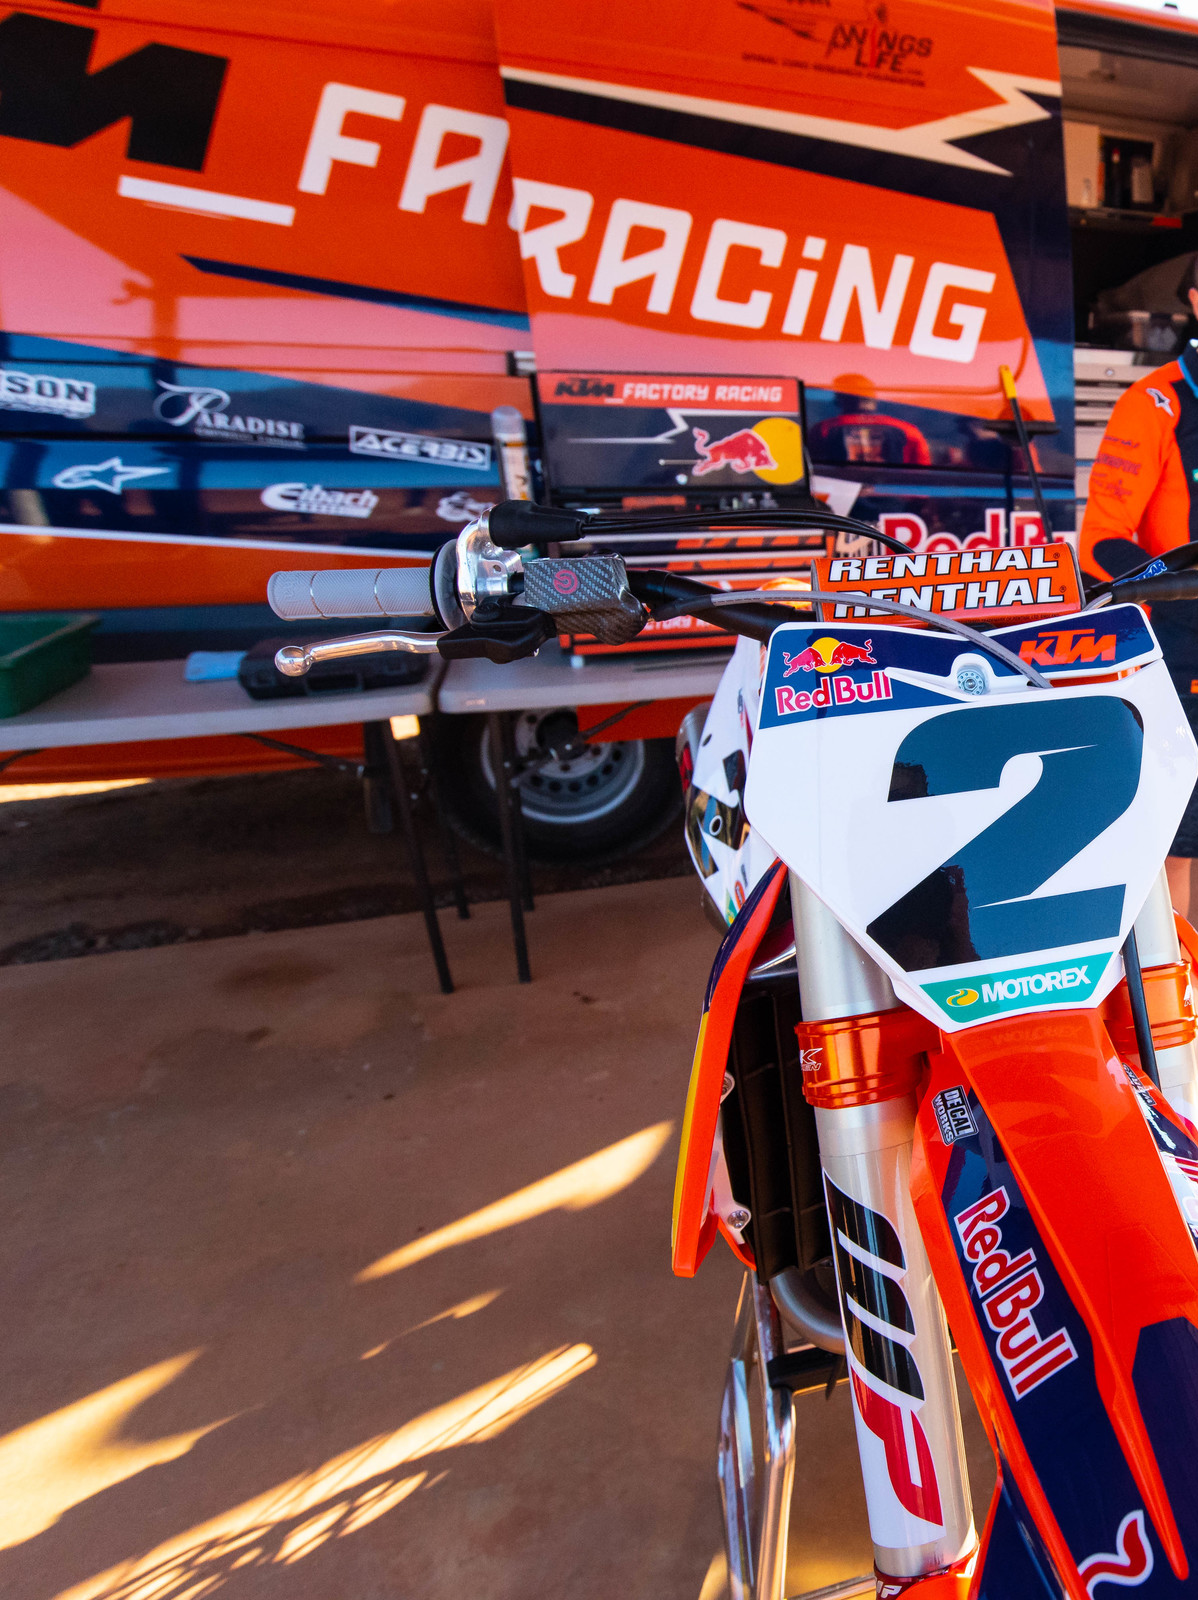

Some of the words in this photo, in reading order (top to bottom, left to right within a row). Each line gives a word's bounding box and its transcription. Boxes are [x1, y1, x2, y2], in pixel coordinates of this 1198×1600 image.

[298, 82, 520, 231] FA
[554, 378, 615, 397] KTM
[622, 382, 709, 401] FACTORY
[828, 547, 1059, 582] RENTHAL
[647, 614, 693, 631] CTORY
[1018, 629, 1116, 665] KTM
[775, 676, 833, 716] Red
[832, 670, 893, 705] Bull
[866, 696, 1144, 972] 2
[982, 965, 1091, 1003] MOTOREX
[934, 1095, 954, 1143] WORKS
[944, 1089, 977, 1136] DECAL
[954, 1185, 1037, 1298] Red
[982, 1266, 1079, 1401] Bull
